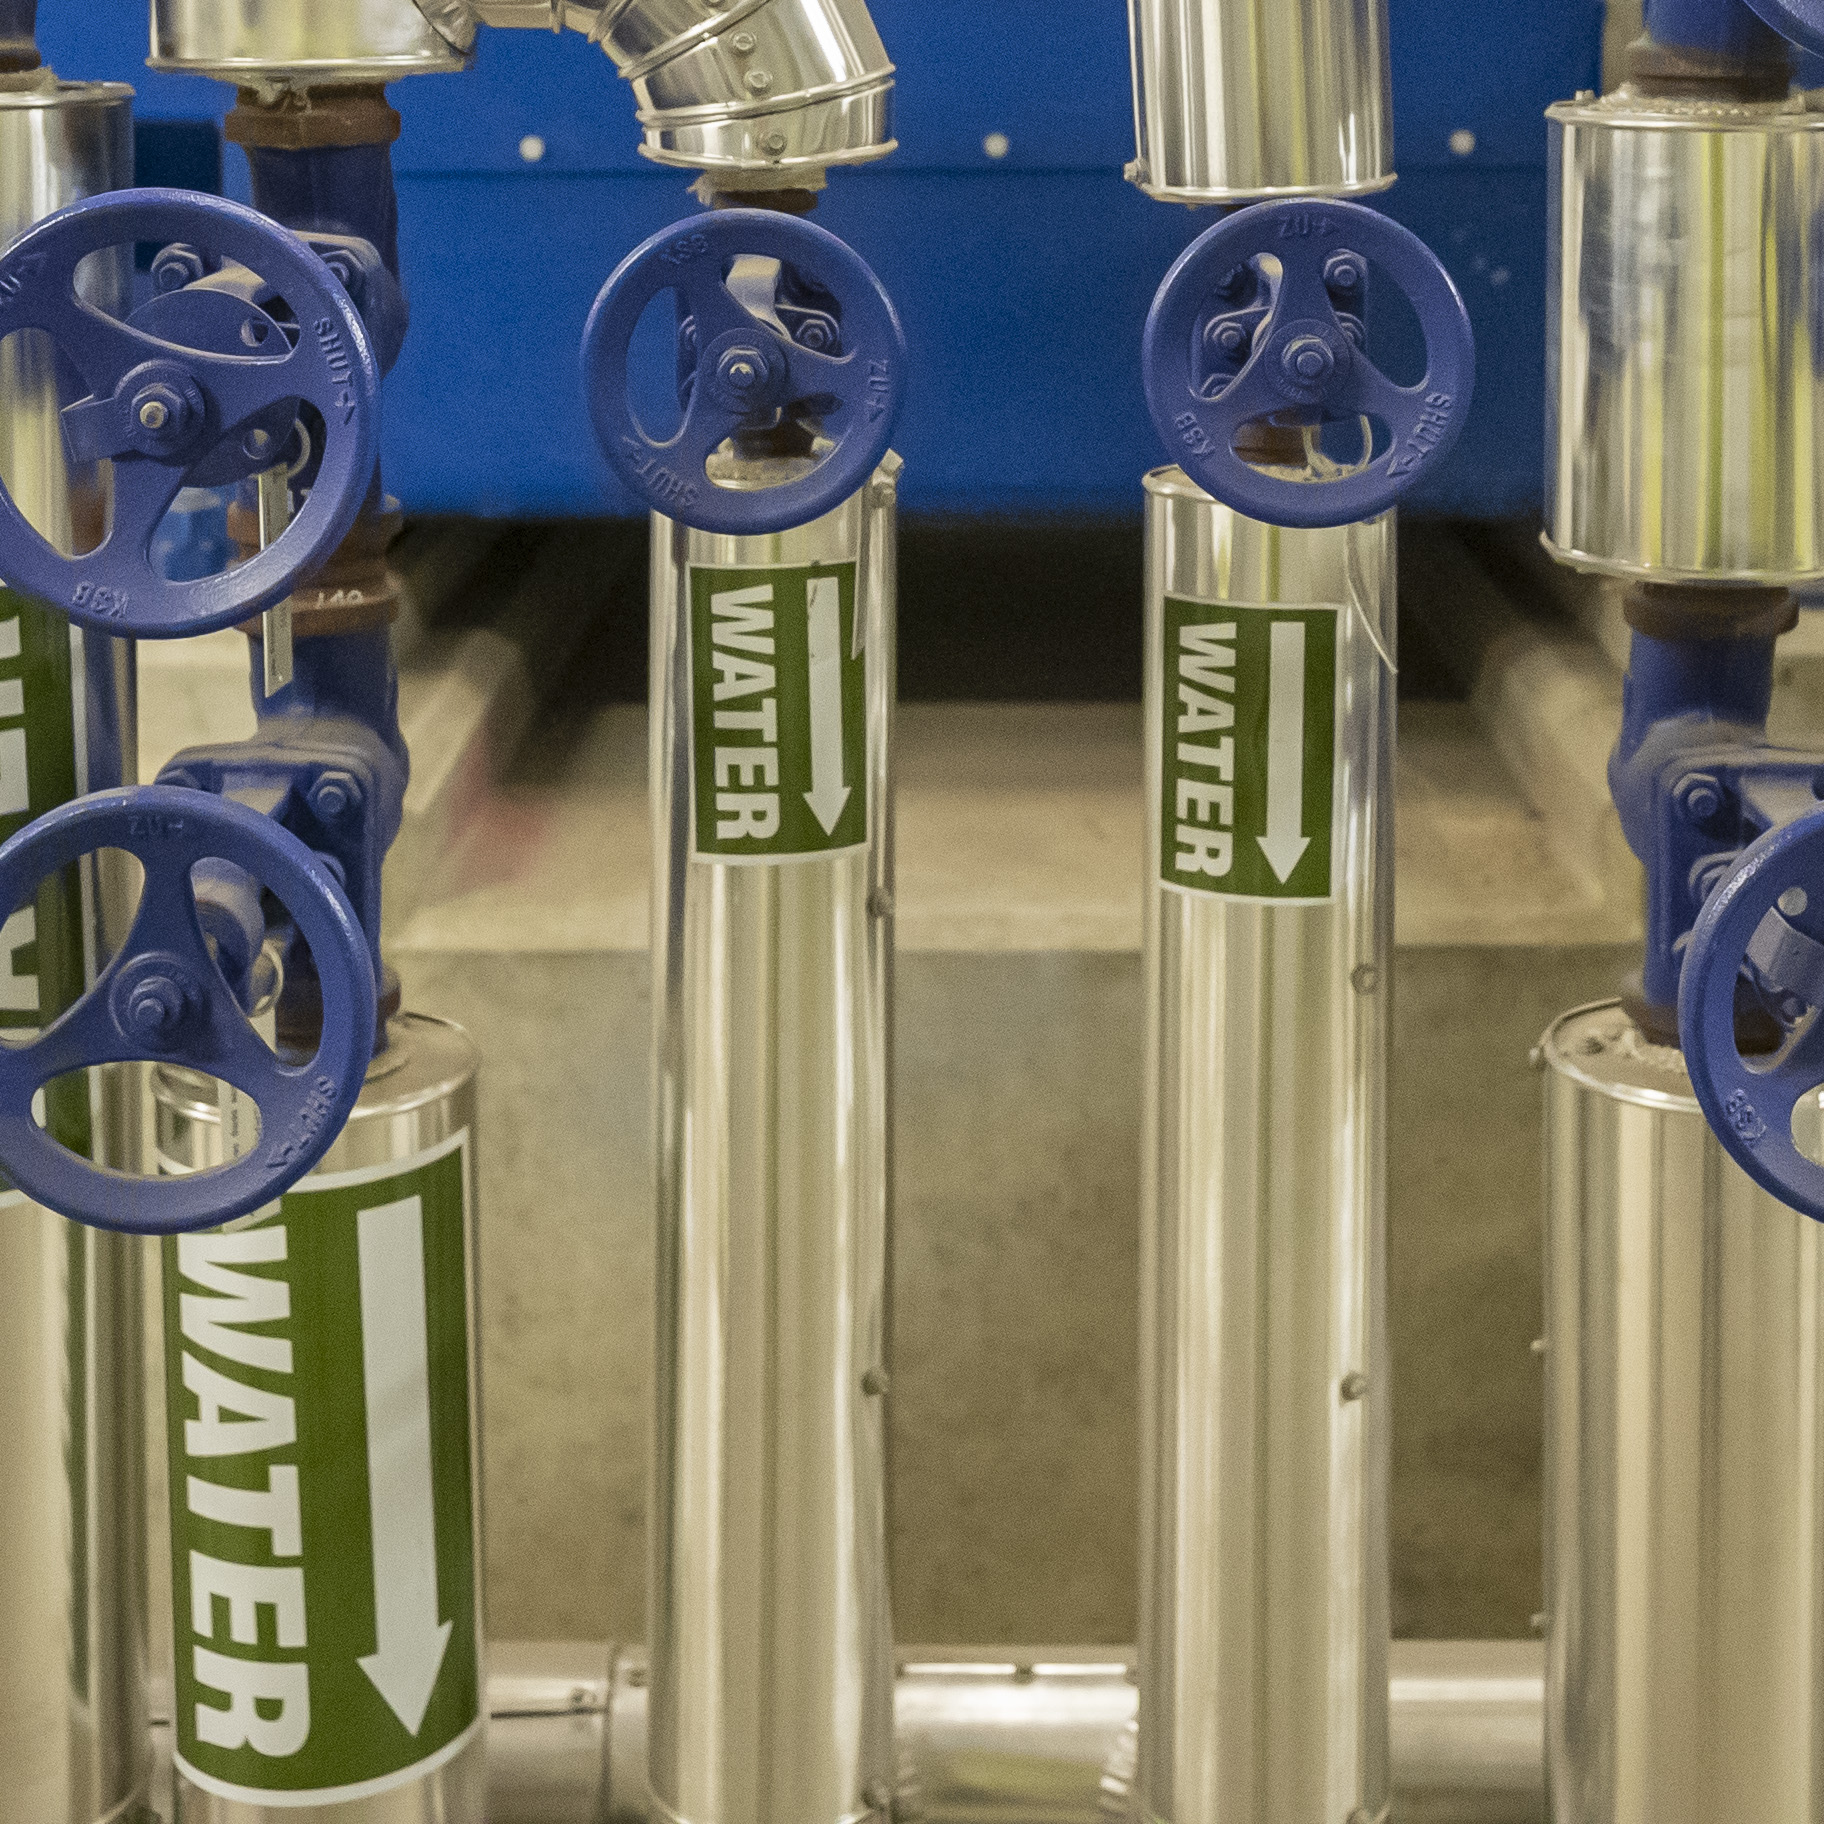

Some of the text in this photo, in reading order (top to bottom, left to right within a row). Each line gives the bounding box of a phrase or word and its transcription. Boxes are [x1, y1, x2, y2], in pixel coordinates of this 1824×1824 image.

[313, 316, 355, 385] SHUT
[1174, 412, 1215, 456] KSB
[1405, 392, 1453, 458] SHUT
[72, 581, 131, 618] KSB
[708, 583, 780, 841] WATER
[1174, 620, 1237, 878] WATER
[177, 1224, 311, 1758] WATER
